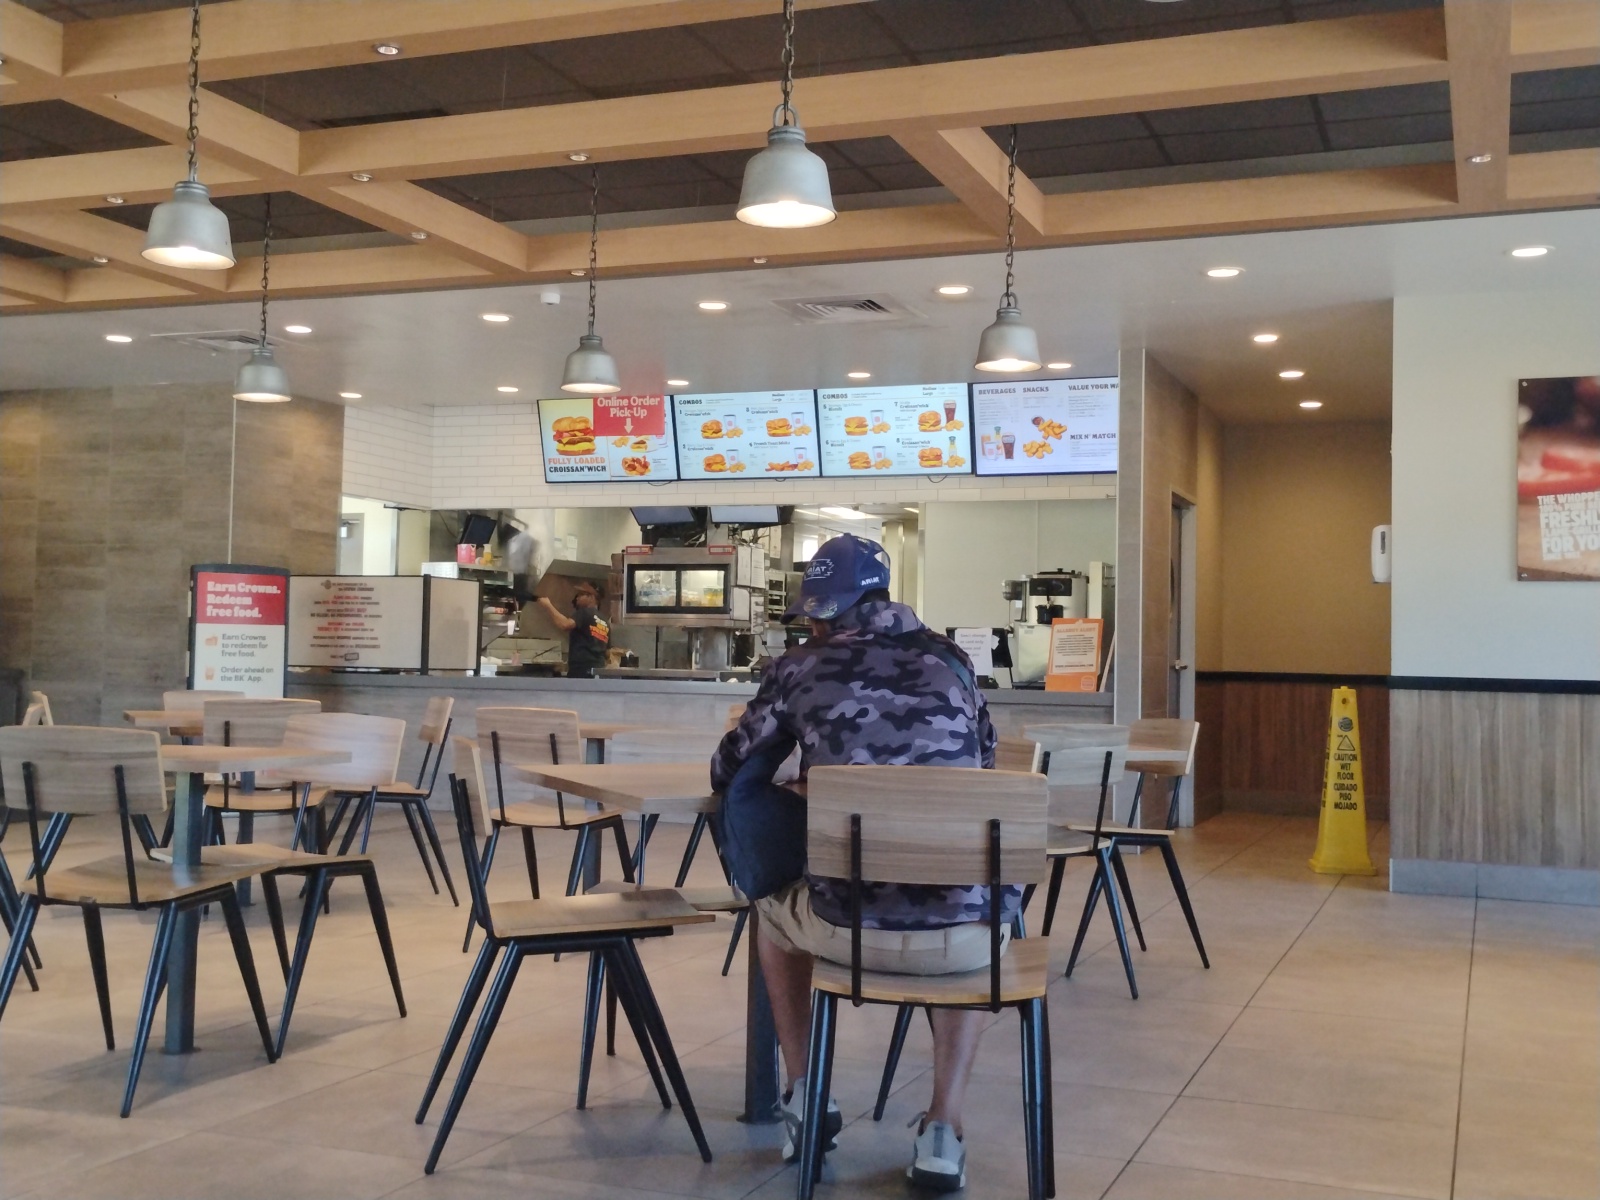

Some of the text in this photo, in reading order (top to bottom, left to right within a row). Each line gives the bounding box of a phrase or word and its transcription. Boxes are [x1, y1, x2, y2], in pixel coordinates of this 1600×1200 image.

[978, 387, 1017, 395] BEVERAGES
[597, 395, 661, 407] Online Order
[609, 407, 648, 418] Pick-Up
[1537, 495, 1556, 505] THE
[1540, 509, 1600, 529] FRESHL
[1542, 536, 1574, 553] FOR
[207, 581, 281, 594] Earn Crowns.
[206, 594, 252, 604] Redeem
[206, 605, 262, 618] free food.
[1334, 753, 1358, 761] CAUTION
[1337, 772, 1354, 780] FLOOR
[1334, 783, 1358, 792] CUIDADO
[1339, 792, 1352, 800] PISO
[1334, 802, 1358, 810] MOJADO
